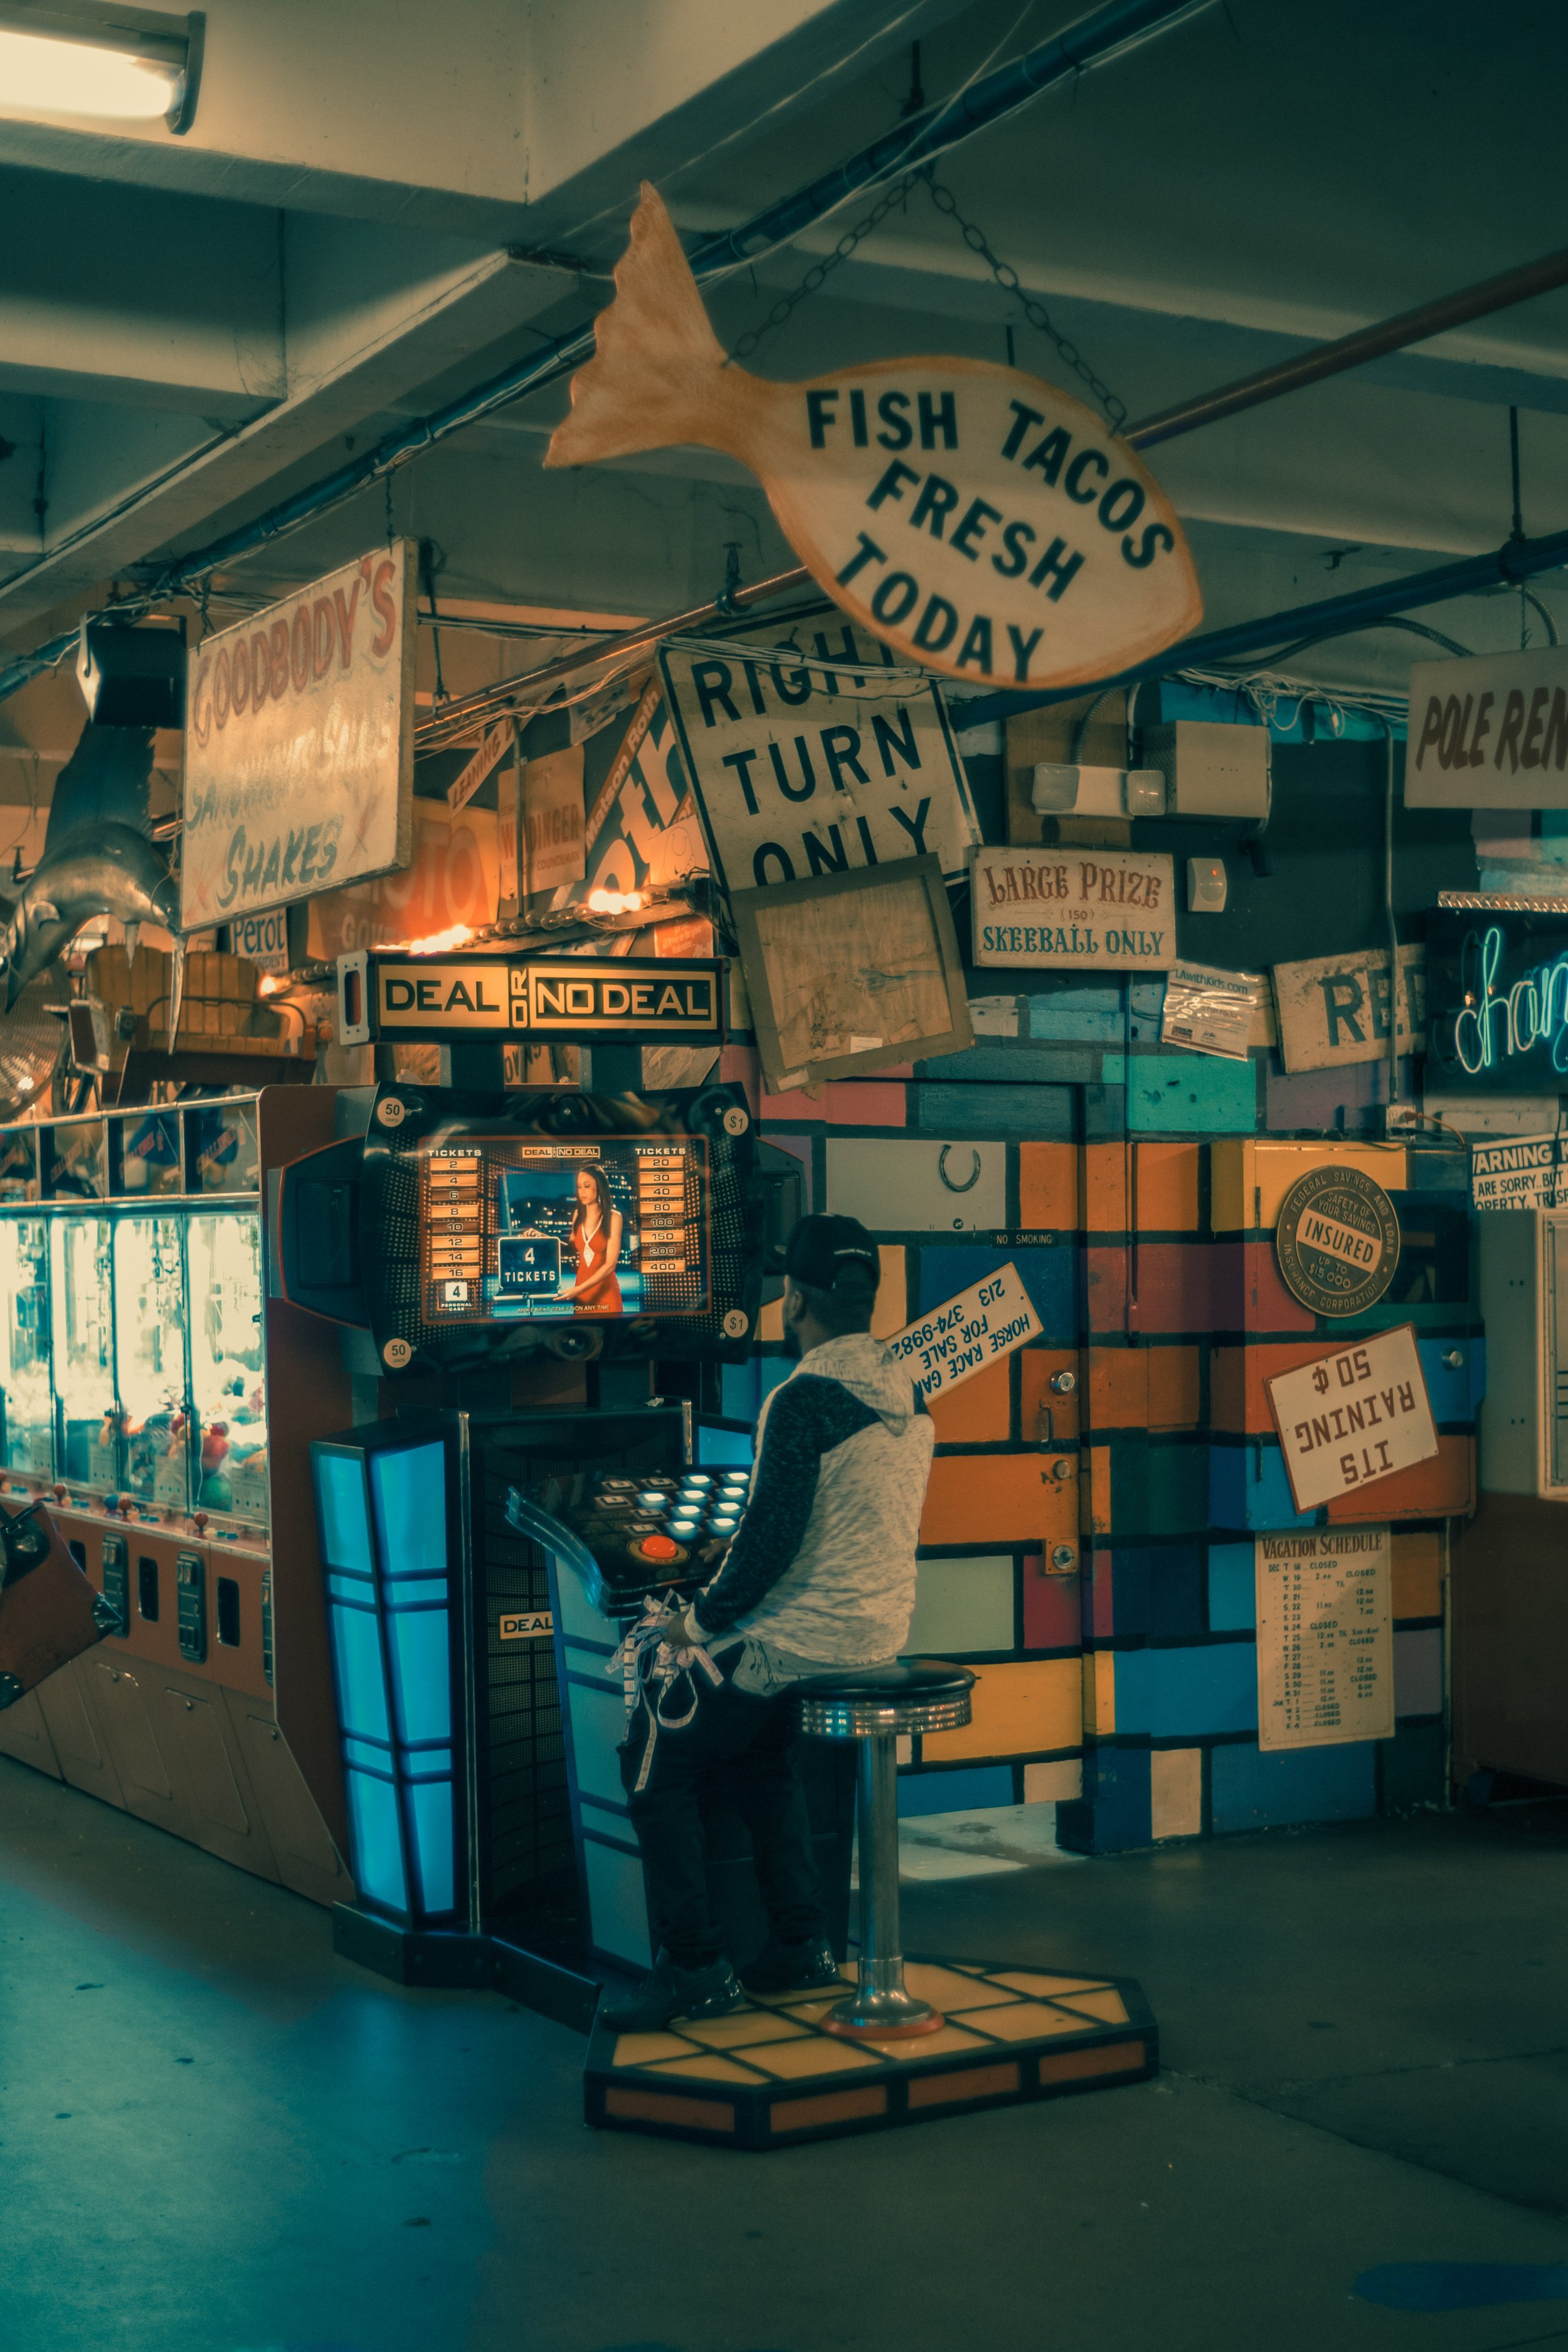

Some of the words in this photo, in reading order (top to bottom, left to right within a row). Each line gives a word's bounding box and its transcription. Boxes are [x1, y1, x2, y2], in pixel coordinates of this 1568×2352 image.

[806, 388, 958, 451] FISH
[1000, 398, 1175, 569] TACOS
[865, 458, 1086, 603] FRESH
[834, 531, 1044, 684] TODAY
[193, 556, 396, 748] GOODBODY'S
[627, 690, 659, 751] Roth
[1416, 692, 1494, 772] POLE
[723, 708, 922, 816] TURN
[585, 755, 630, 854] Matson
[217, 813, 346, 909] SHAKES
[983, 864, 1070, 906] LARGE
[1079, 861, 1162, 909] PRIZE
[233, 912, 285, 956] Perot
[982, 925, 1099, 955] SKEEBALL
[1105, 929, 1165, 956] ONLY
[1175, 968, 1248, 995] LAwithKids.com
[385, 979, 501, 1012] DEAL
[511, 968, 528, 1028] OR
[537, 983, 595, 1014] NO
[602, 983, 709, 1015] DEAL
[385, 1104, 400, 1116] 50
[729, 1115, 743, 1130] $1
[428, 1149, 482, 1157] TICKETS
[1472, 1143, 1553, 1174] ARNING
[450, 1191, 458, 1199] 6
[1478, 1180, 1497, 1197] ARE
[1290, 1174, 1327, 1213] FEDERAL
[1333, 1172, 1370, 1192] SAVINGS
[1374, 1195, 1389, 1216] AND
[1384, 1223, 1394, 1254] LOAN
[1318, 1199, 1340, 1218] YOUR
[1342, 1211, 1376, 1233] SAVINGS
[1327, 1192, 1358, 1213] SAFETY
[1360, 1205, 1370, 1217] OF
[651, 1218, 674, 1227] 100
[448, 1238, 462, 1246] 12
[650, 1247, 676, 1256] 200
[996, 1234, 1008, 1244] NO
[1015, 1234, 1052, 1244] SMOKING
[1305, 1217, 1374, 1264] INSURED
[524, 1247, 534, 1264] 4
[650, 1263, 675, 1271] 400
[1318, 1256, 1330, 1266] UP
[1336, 1263, 1347, 1274] TO
[505, 1270, 556, 1282] TICKETS
[1283, 1243, 1316, 1298] INSURANCE
[1320, 1273, 1380, 1310] CORPORATION
[452, 1285, 460, 1298] 4
[978, 1278, 1005, 1306] 213
[729, 1316, 743, 1330] $1
[960, 1314, 988, 1343] FOR
[988, 1313, 1030, 1353] HORSE
[391, 1344, 406, 1356] 50
[919, 1335, 958, 1370] SALE
[947, 1343, 983, 1380] RACE
[1335, 1349, 1372, 1388] 50
[1294, 1380, 1416, 1454] RAINING
[1339, 1439, 1394, 1485] ITS
[1263, 1537, 1317, 1559] VACATION
[1320, 1533, 1382, 1555] SCHEDULE
[1269, 1564, 1280, 1572] DEC
[1310, 1560, 1338, 1570] CLOSED
[1346, 1568, 1376, 1577] CLOSED
[504, 1616, 553, 1633] DEAL
[1310, 1621, 1338, 1630] CLOSED
[1349, 1636, 1375, 1646] CLOSED
[1350, 1673, 1377, 1682] CLOSED
